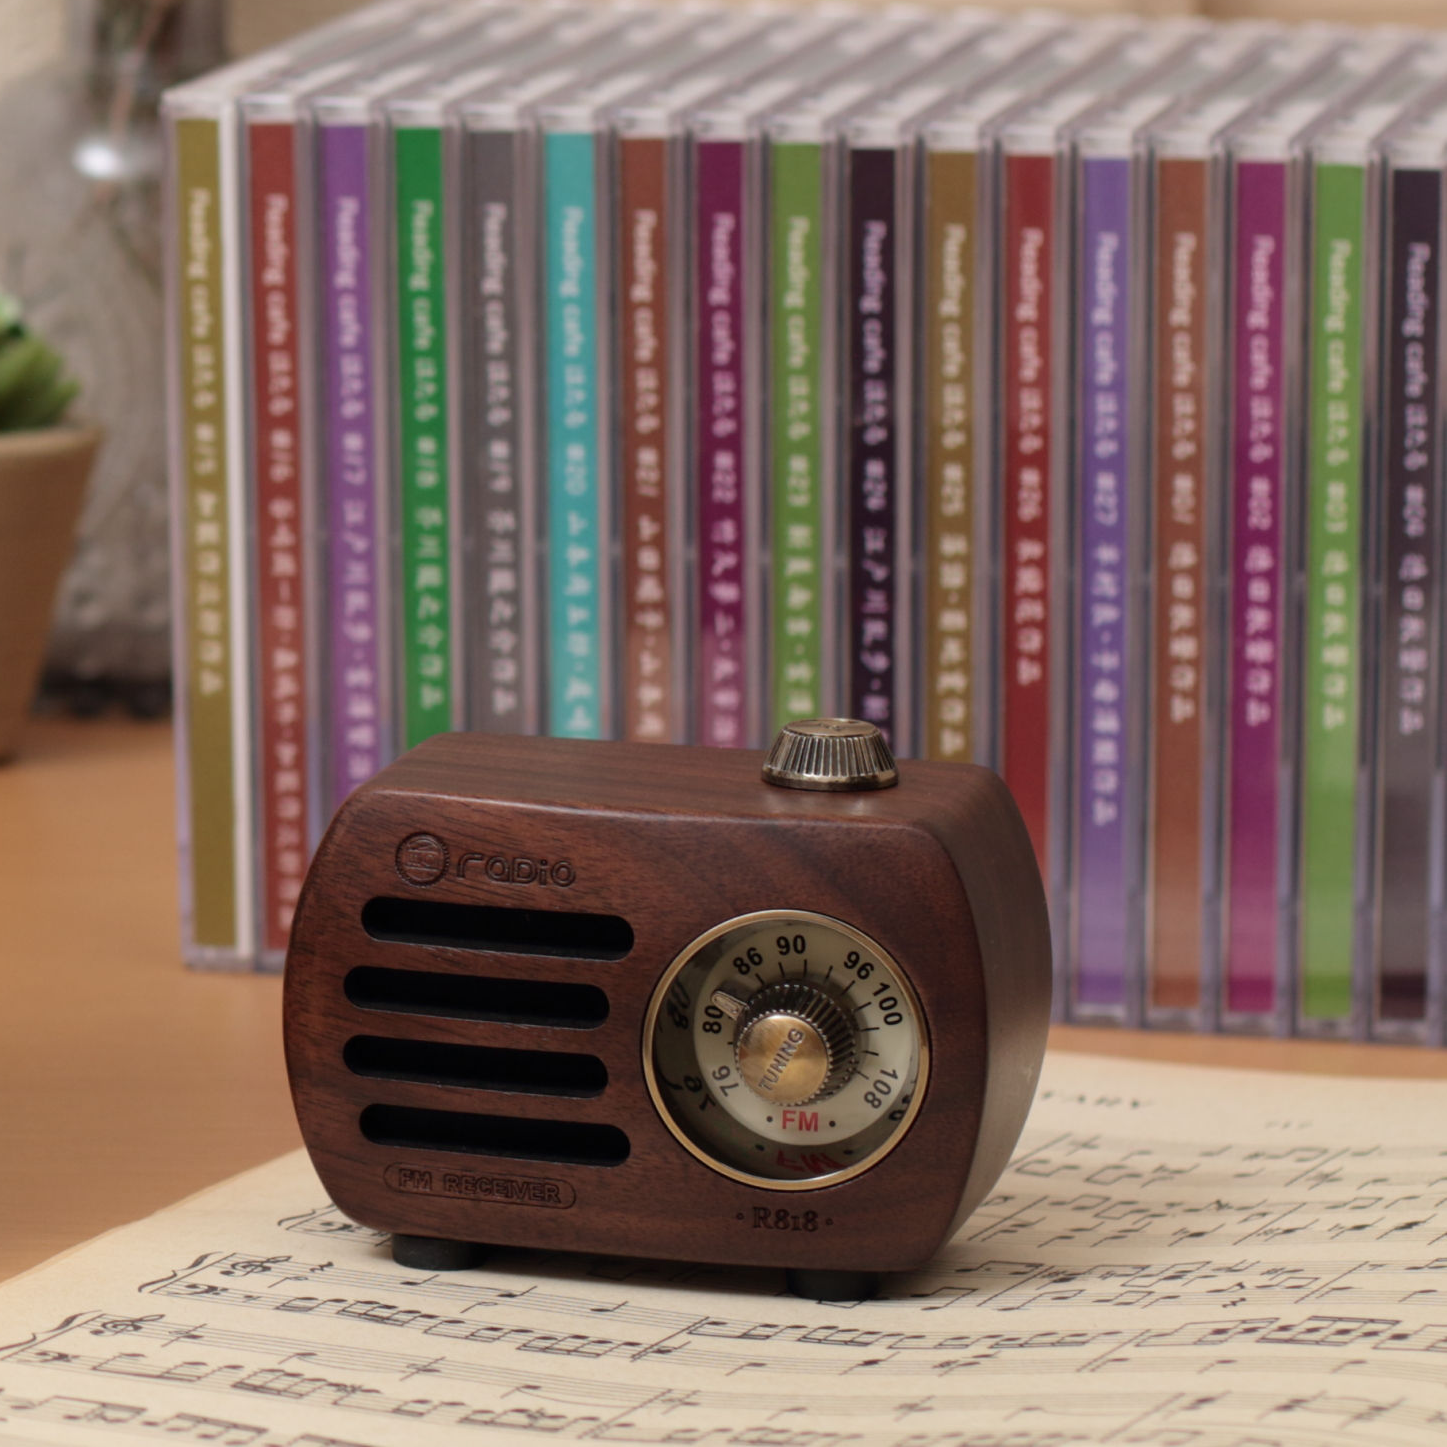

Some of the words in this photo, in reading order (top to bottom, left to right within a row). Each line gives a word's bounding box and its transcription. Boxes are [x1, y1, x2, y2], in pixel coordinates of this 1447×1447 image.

[188, 188, 209, 279] Reading
[263, 193, 288, 285] Reading
[335, 196, 358, 289] Reading
[409, 199, 434, 292] Reading
[482, 202, 506, 295] Reading
[559, 206, 584, 298] Reading
[631, 209, 656, 302] Reading
[709, 212, 734, 306] Reading
[784, 216, 809, 309] Reading
[860, 220, 886, 314] Reading
[939, 224, 965, 317] Reading
[1016, 228, 1043, 322] Reading
[1092, 232, 1118, 326] Reading
[1169, 232, 1196, 326] Reading
[1247, 235, 1274, 330] Reading
[1324, 238, 1351, 333] Reading
[1402, 242, 1430, 337] Reading
[191, 285, 211, 338] cafe
[267, 291, 289, 346] cafe
[339, 294, 360, 348] cafe
[413, 297, 435, 351] cafe
[486, 300, 507, 355] cafe
[563, 304, 584, 358] cafe
[635, 307, 656, 362] cafe
[712, 310, 734, 366] cafe
[787, 315, 808, 368] cafe
[863, 318, 884, 374] cafe
[943, 323, 963, 377] cafe
[1020, 327, 1041, 382] cafe
[1095, 332, 1116, 386] cafe
[1173, 332, 1195, 387] cafe
[1250, 335, 1272, 390] cafe
[1327, 339, 1348, 394] cafe
[1405, 342, 1427, 398] cafe
[732, 946, 763, 976] 86
[776, 934, 806, 955] 90
[843, 950, 875, 981] 96
[702, 1004, 723, 1035] 80
[872, 982, 903, 1027] 100
[711, 1065, 740, 1098] 76
[758, 1027, 805, 1092] TUNING
[863, 1067, 899, 1110] 108
[781, 1110, 819, 1132] FM
[397, 1167, 431, 1192] FM
[443, 1173, 562, 1204] RECEIVER
[752, 1206, 819, 1234] R818
